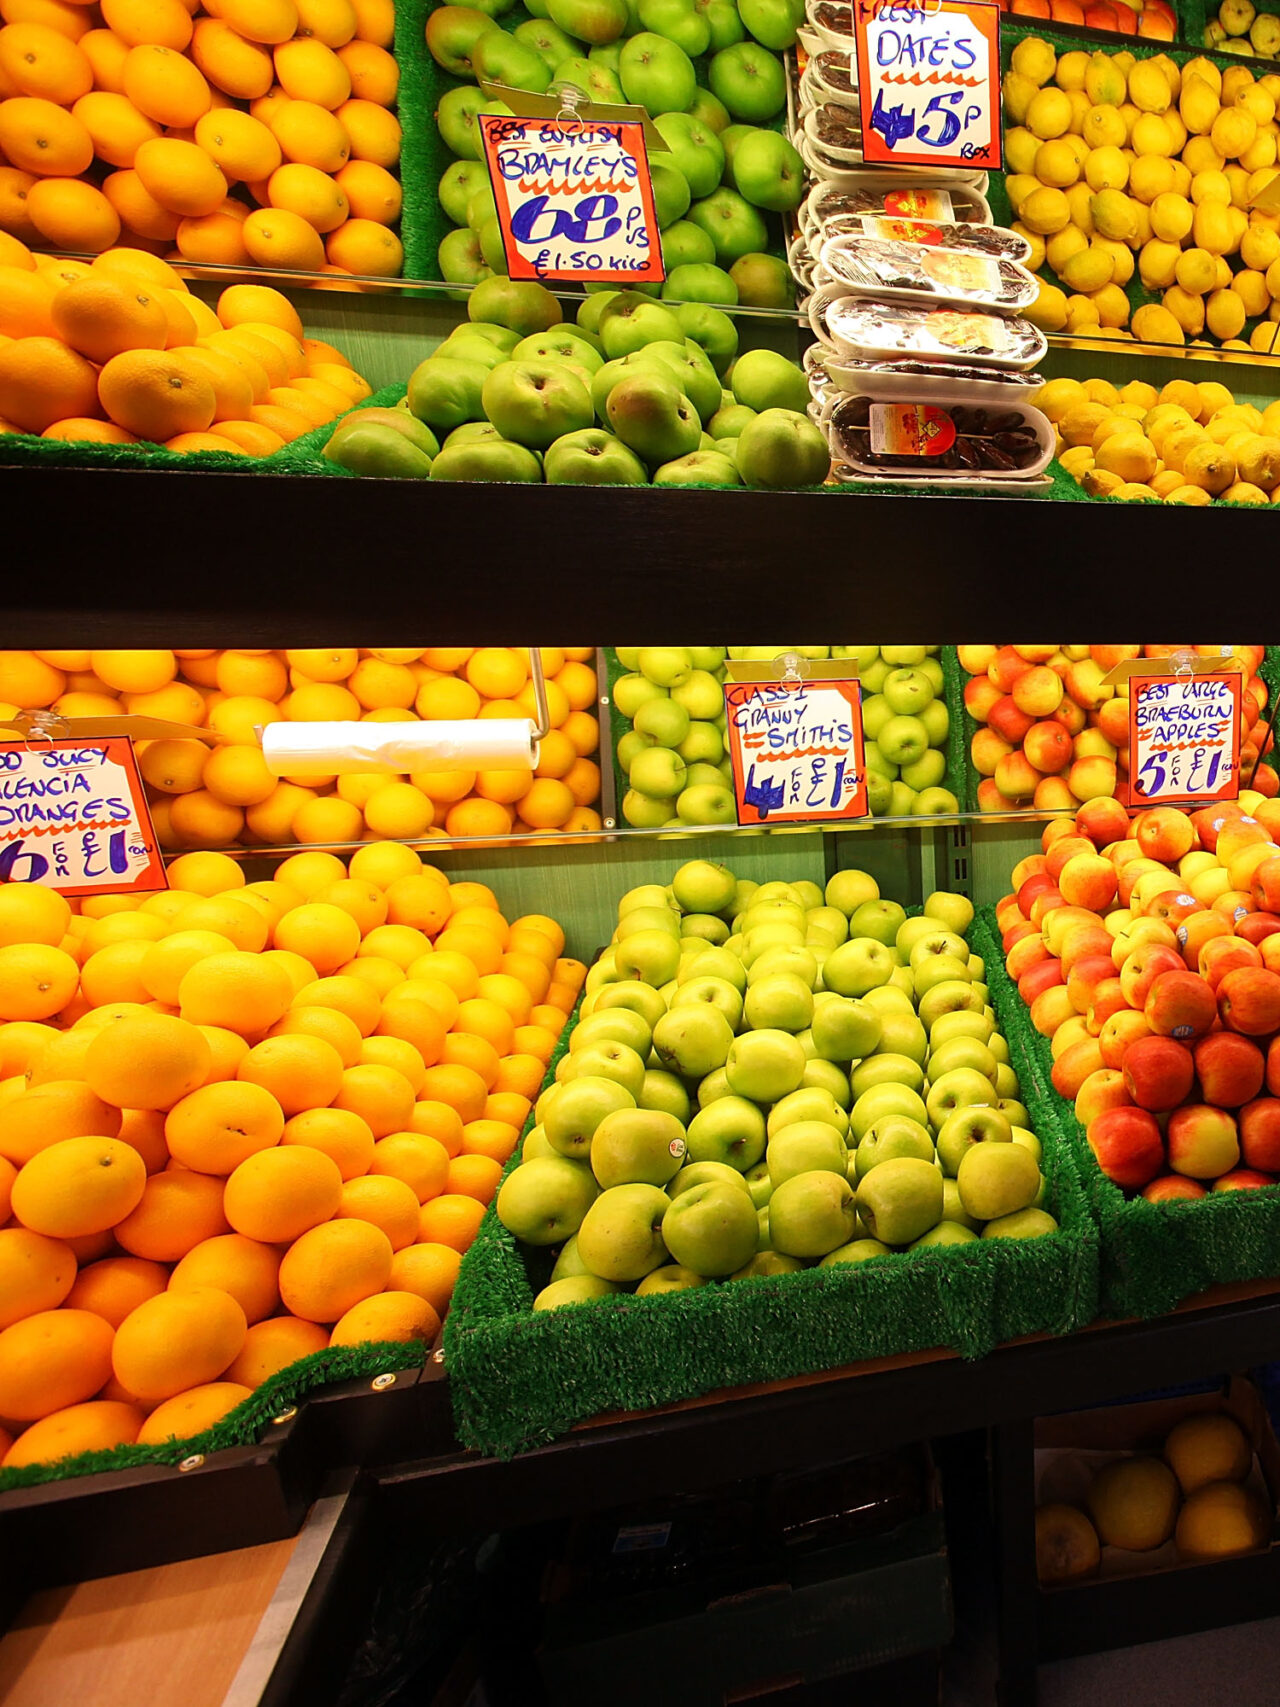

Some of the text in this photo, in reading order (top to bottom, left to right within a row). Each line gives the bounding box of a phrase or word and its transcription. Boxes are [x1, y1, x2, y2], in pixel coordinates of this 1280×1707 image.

[485, 119, 531, 143] BEST
[1136, 683, 1176, 704] BEST
[1135, 704, 1232, 727] BRAEBURN
[1153, 723, 1220, 743] APPLES
[39, 746, 109, 768] JUICY
[1134, 751, 1168, 797] 5
[0, 773, 91, 800] LENCIA
